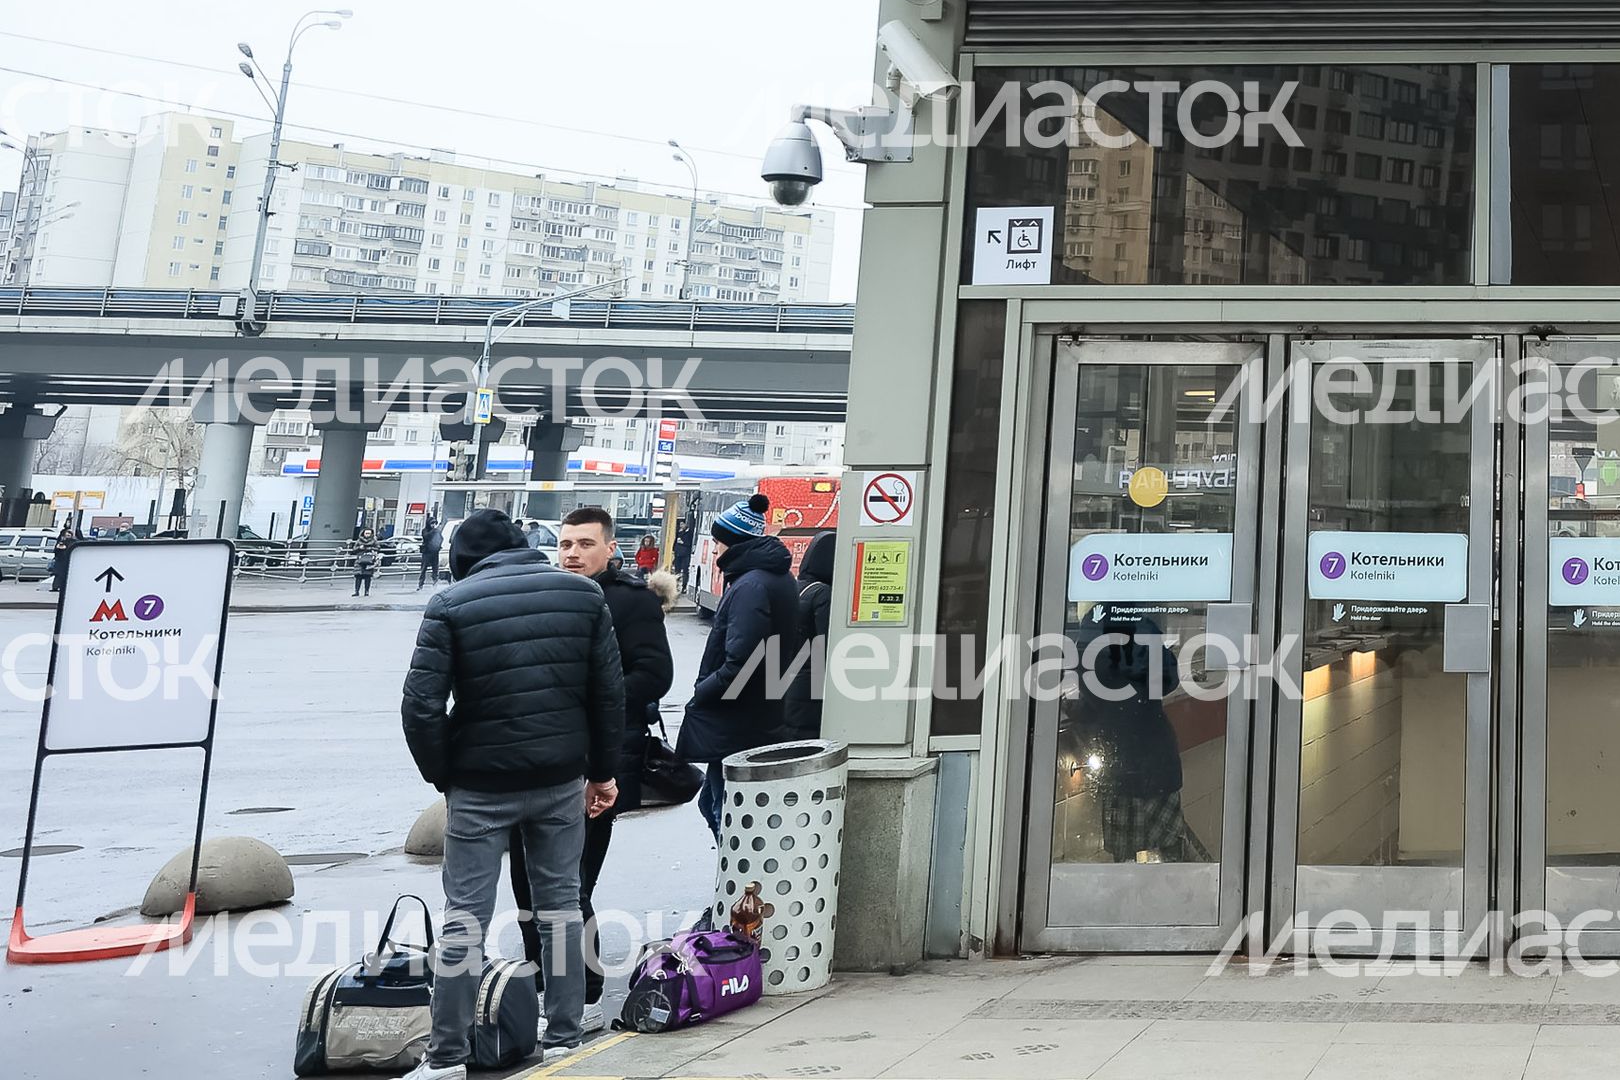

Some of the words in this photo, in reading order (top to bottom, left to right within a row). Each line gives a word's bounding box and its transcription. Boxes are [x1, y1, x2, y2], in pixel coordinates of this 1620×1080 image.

[1005, 259, 1037, 270] Лифт
[1090, 560, 1102, 575] 7
[1113, 554, 1209, 566] Котельники
[1328, 558, 1339, 574] 7
[1351, 552, 1445, 567] Котельники
[1113, 571, 1159, 581] Kotelniki
[1350, 570, 1395, 581] Kotelniki
[1570, 564, 1581, 579] 7
[143, 600, 156, 615] 7
[89, 627, 182, 640] Котельники
[87, 645, 136, 656] Kotelniki
[721, 975, 749, 997] FILA
